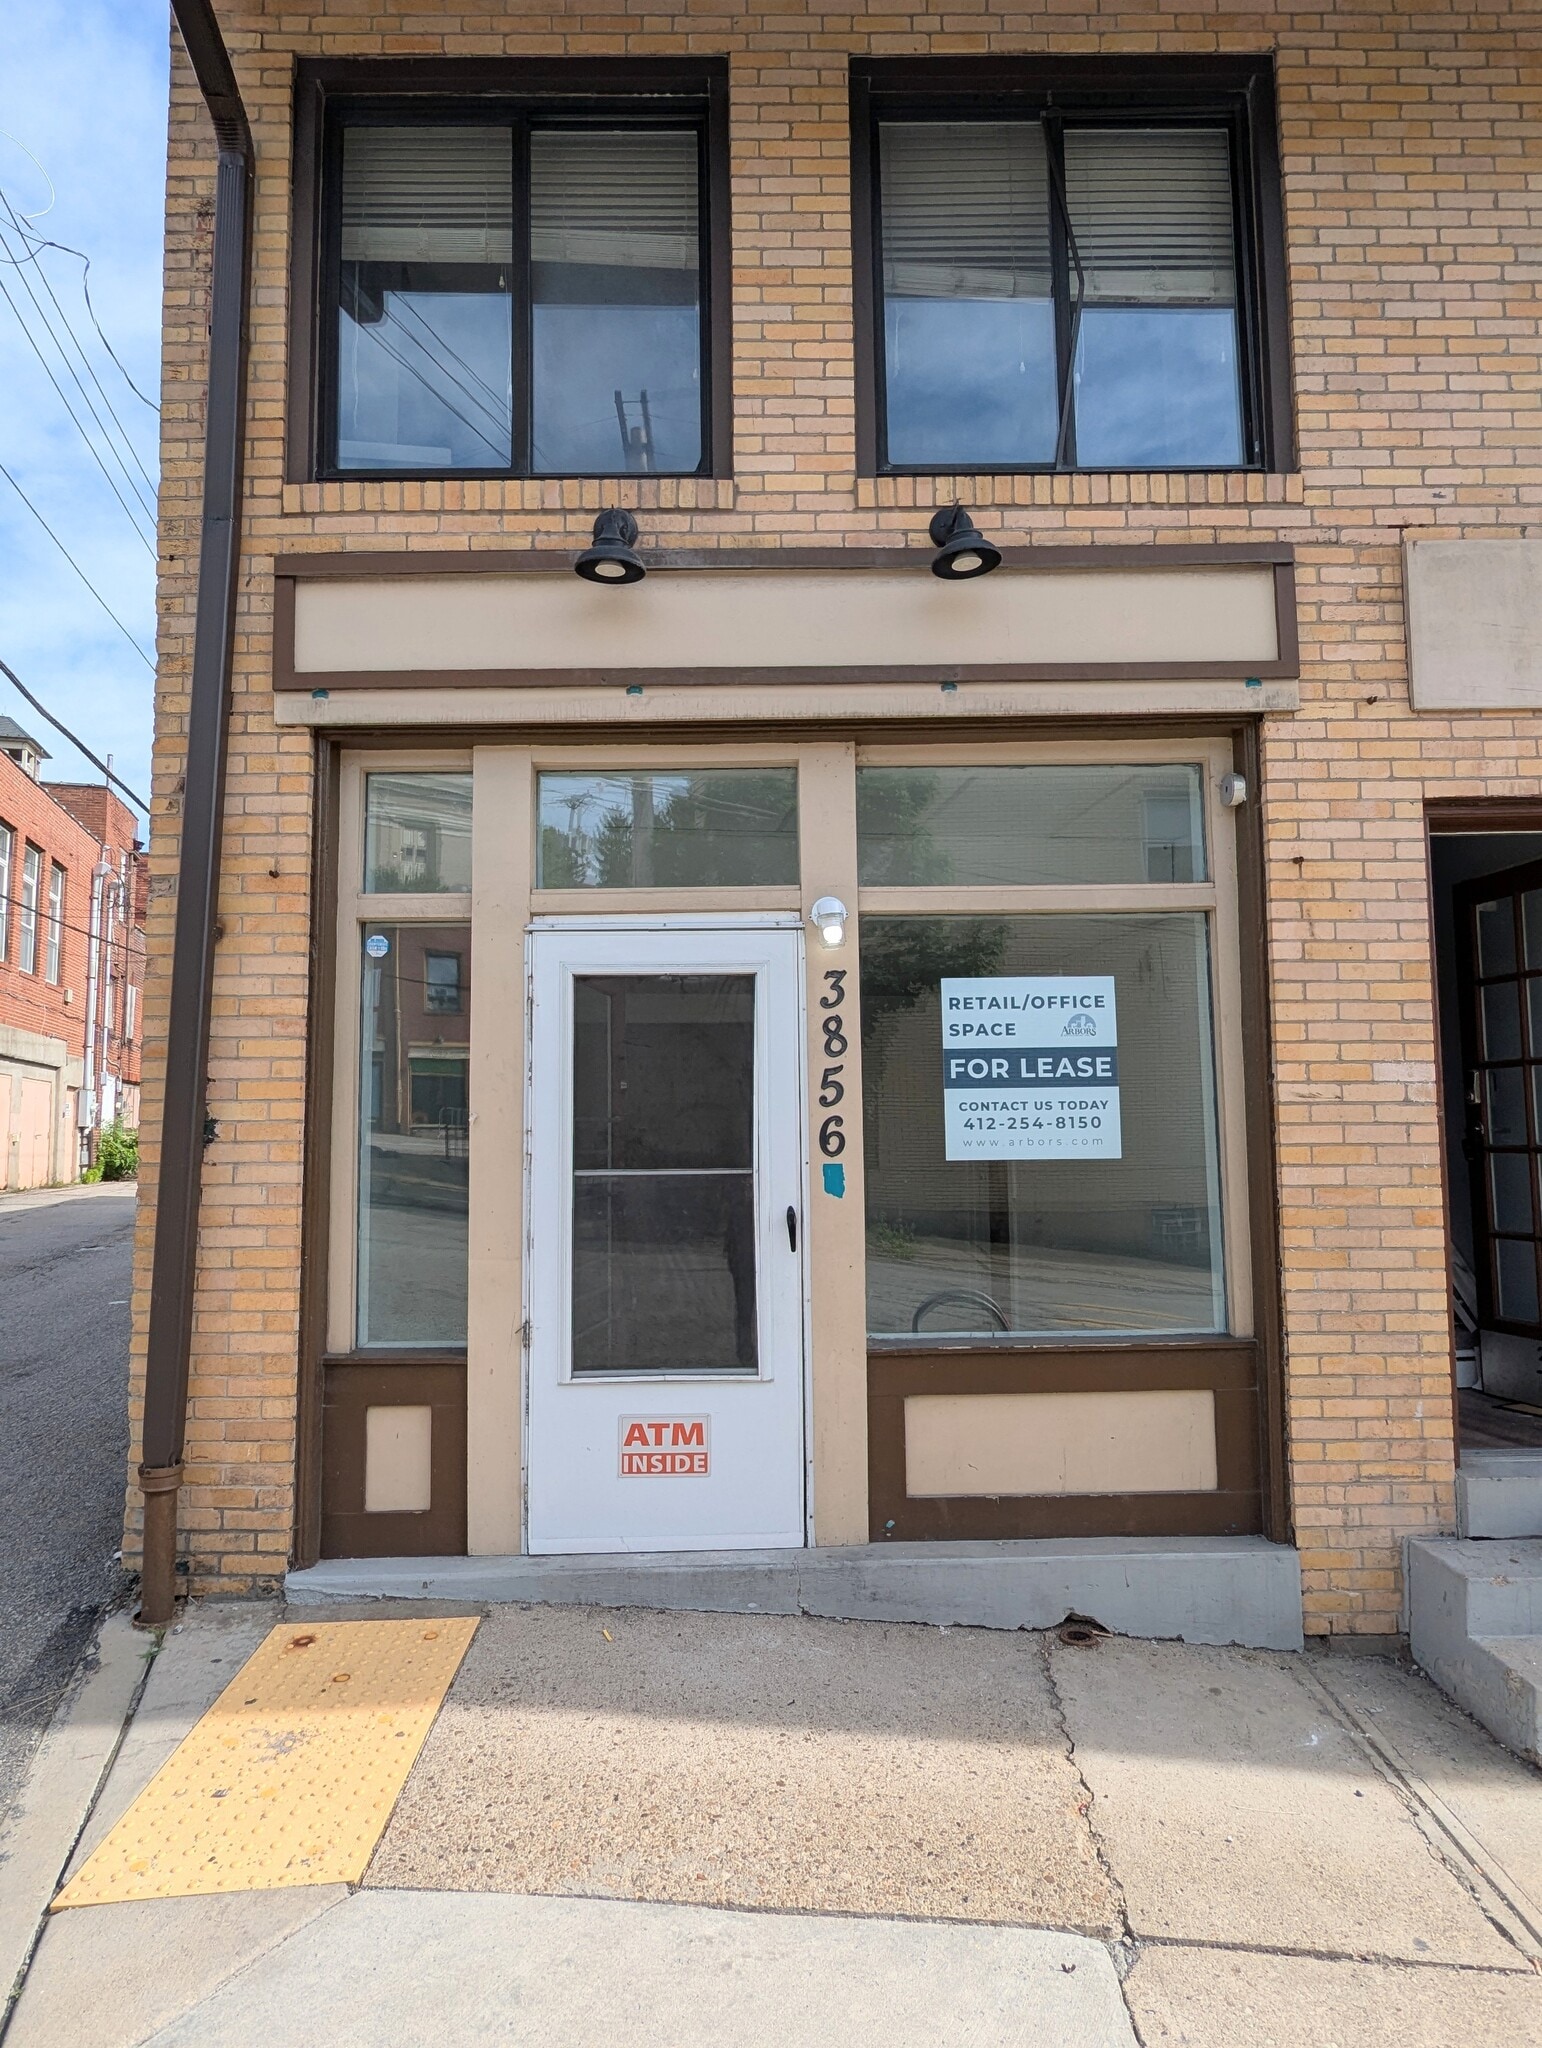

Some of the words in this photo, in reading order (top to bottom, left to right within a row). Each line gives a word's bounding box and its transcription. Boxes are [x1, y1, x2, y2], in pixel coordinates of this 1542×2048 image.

[948, 994, 1106, 1011] RETAIL/OFFICE
[948, 1022, 1016, 1037] SPACE
[1060, 1026, 1097, 1037] ARBORS
[818, 969, 848, 1158] 3856
[950, 1058, 1009, 1079] FOR
[1020, 1057, 1112, 1078] LEASE
[958, 1101, 1028, 1112] CONTACT
[1034, 1100, 1053, 1111] US
[1058, 1100, 1109, 1110] TODAY
[963, 1116, 1102, 1130] 412-254-8150
[962, 1136, 1103, 1147] www.arbors.com
[623, 1422, 704, 1446] ATM
[623, 1455, 705, 1472] INSIDE
